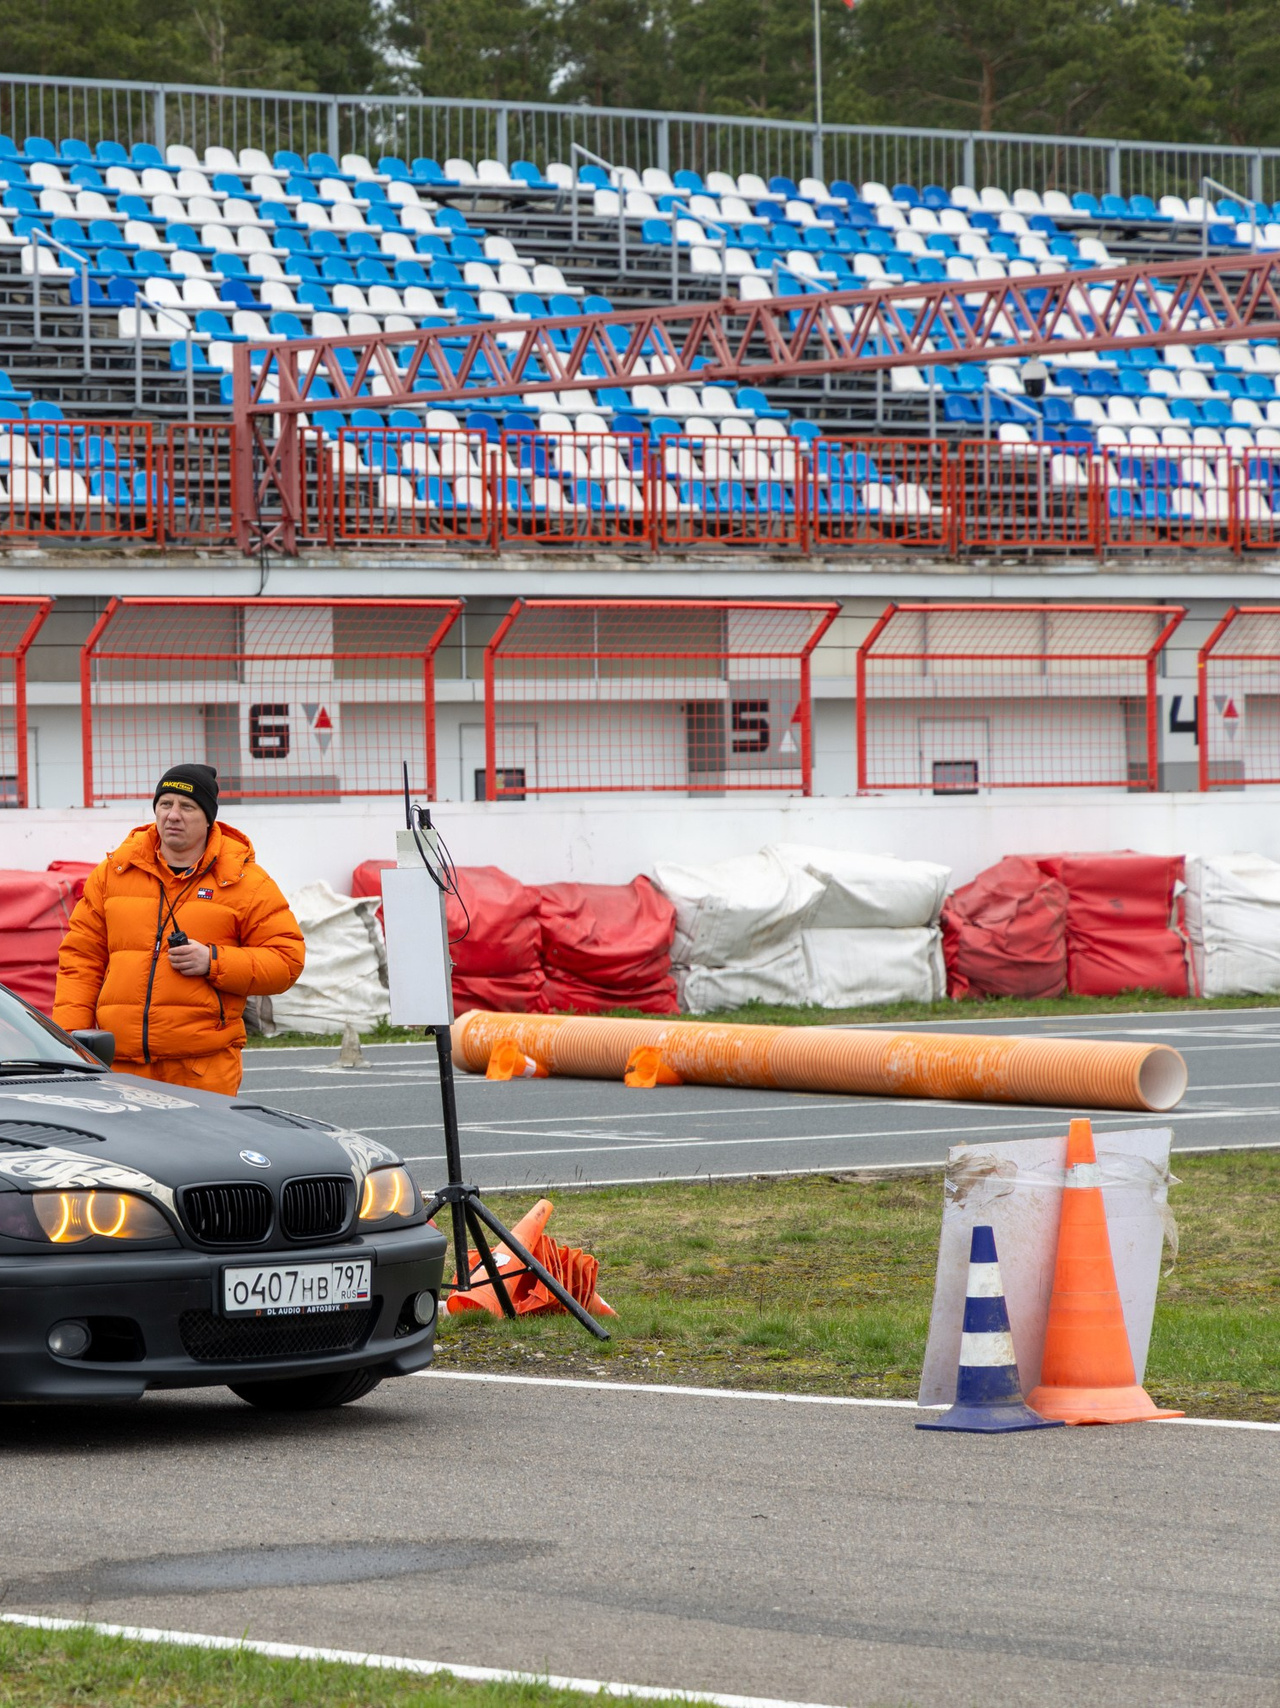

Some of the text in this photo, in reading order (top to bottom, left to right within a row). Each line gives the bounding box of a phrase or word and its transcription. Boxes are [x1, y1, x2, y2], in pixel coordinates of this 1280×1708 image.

[249, 703, 290, 759] 6
[732, 699, 770, 753] 5
[1169, 695, 1200, 746] 4
[334, 1264, 365, 1292] 797
[341, 1289, 357, 1300] RUS
[267, 1308, 277, 1316] DL
[278, 1306, 301, 1315] AUDIO
[307, 1304, 340, 1313] АВТОЗВУК
